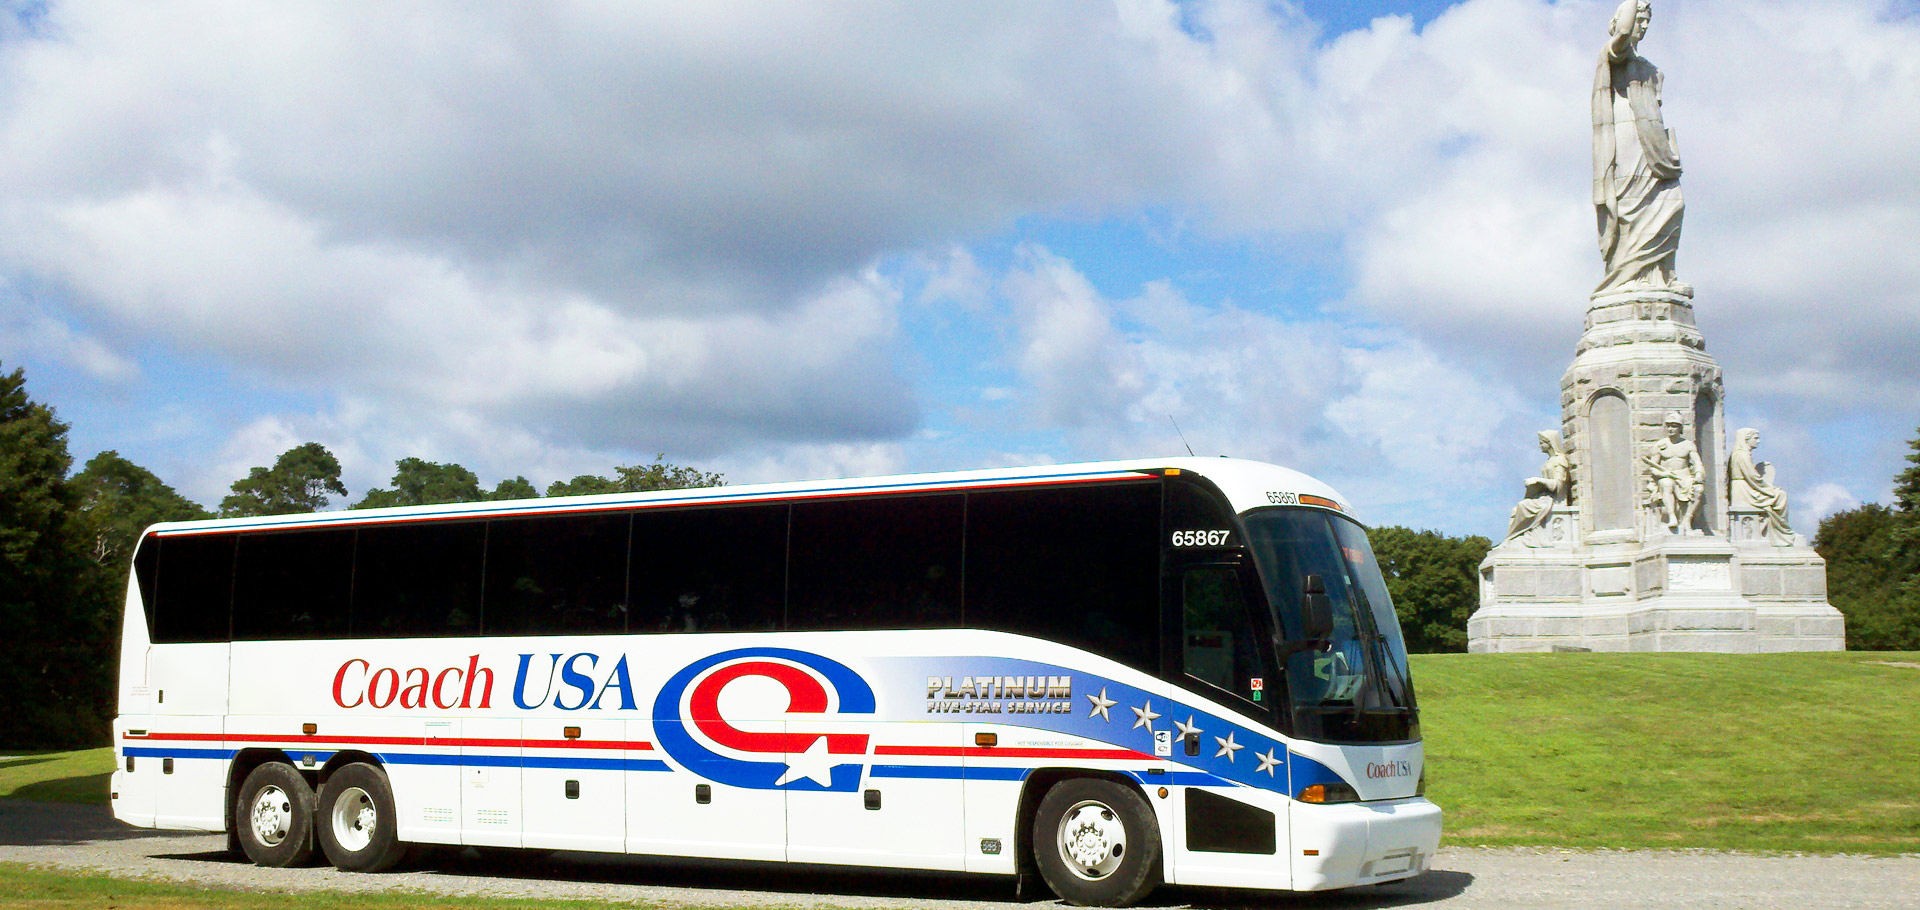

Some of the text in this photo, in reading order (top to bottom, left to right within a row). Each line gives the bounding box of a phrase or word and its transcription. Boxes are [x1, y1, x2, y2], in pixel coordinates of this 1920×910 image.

[1265, 491, 1298, 505] 65867
[1171, 529, 1231, 547] 65867
[332, 652, 639, 711] Coach USA
[926, 675, 1072, 700] PLATINUM
[926, 701, 1072, 714] FIVE-STAR SERVICE
[1366, 760, 1412, 779] Coach USA
